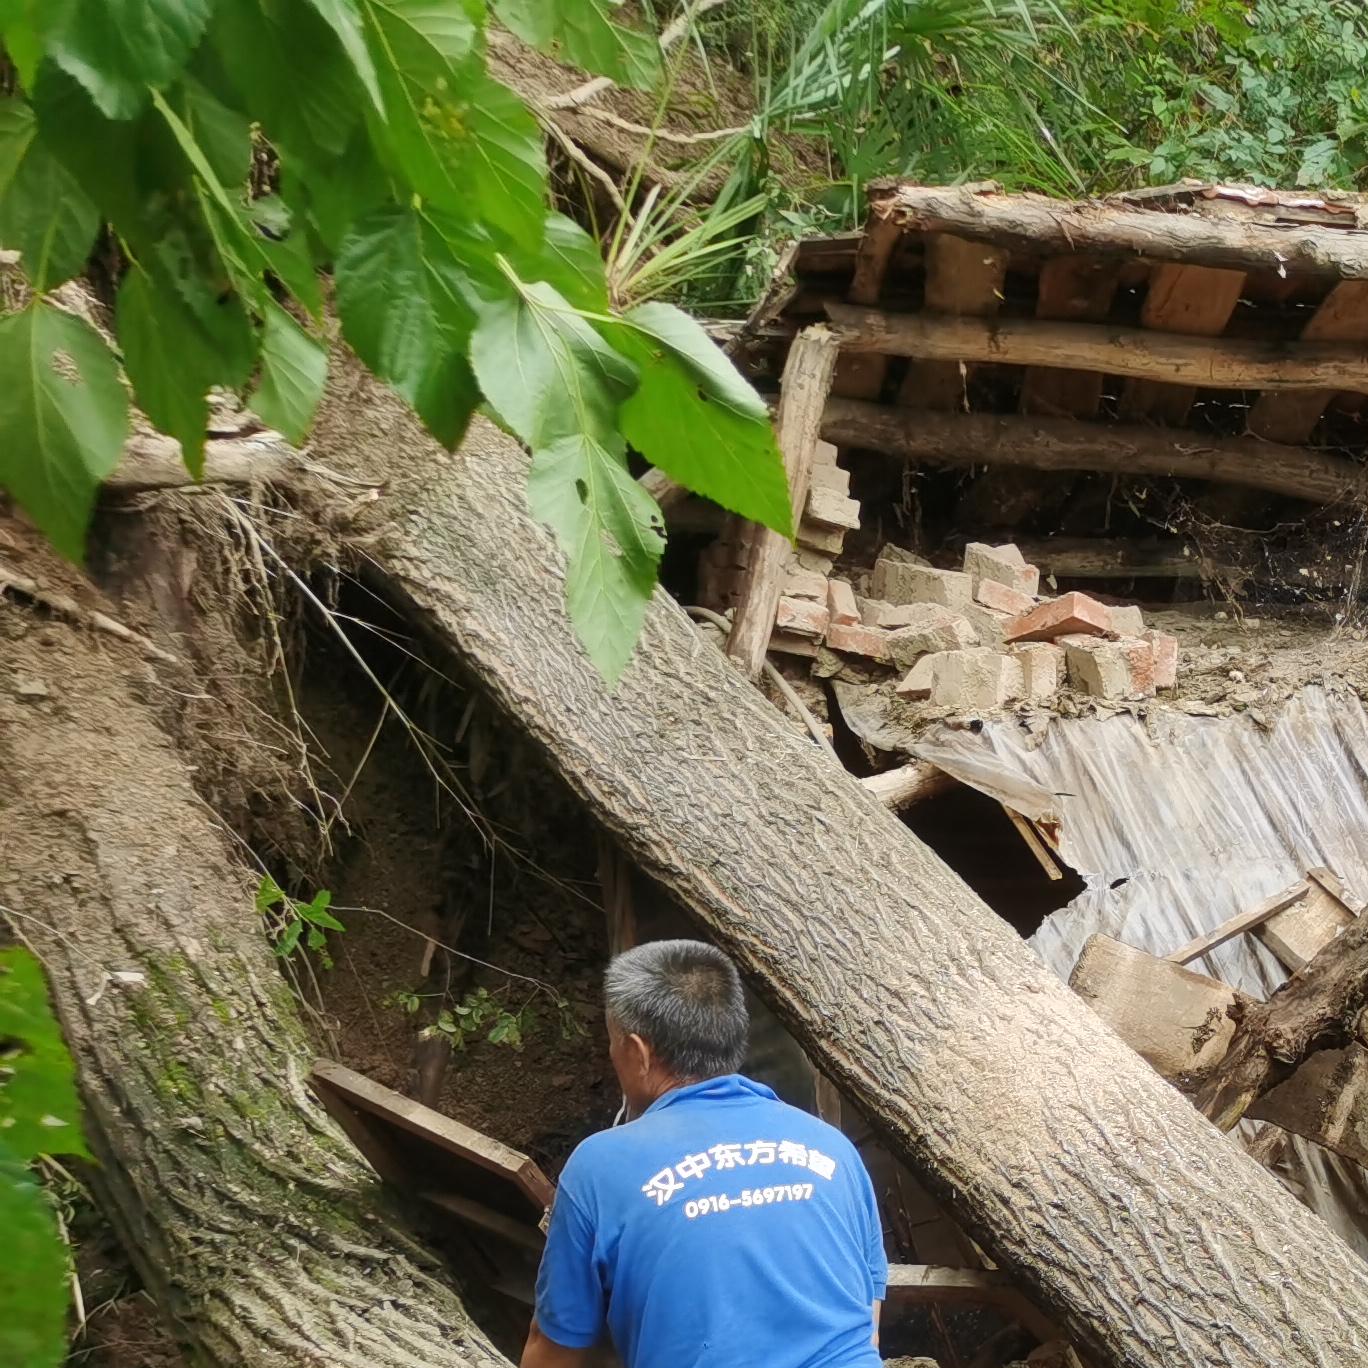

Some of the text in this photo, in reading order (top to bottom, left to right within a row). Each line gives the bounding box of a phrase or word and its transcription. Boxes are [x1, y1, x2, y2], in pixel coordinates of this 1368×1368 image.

[641, 1139, 837, 1206] 汉中东方希望
[684, 1183, 814, 1219] 0916-5697197
